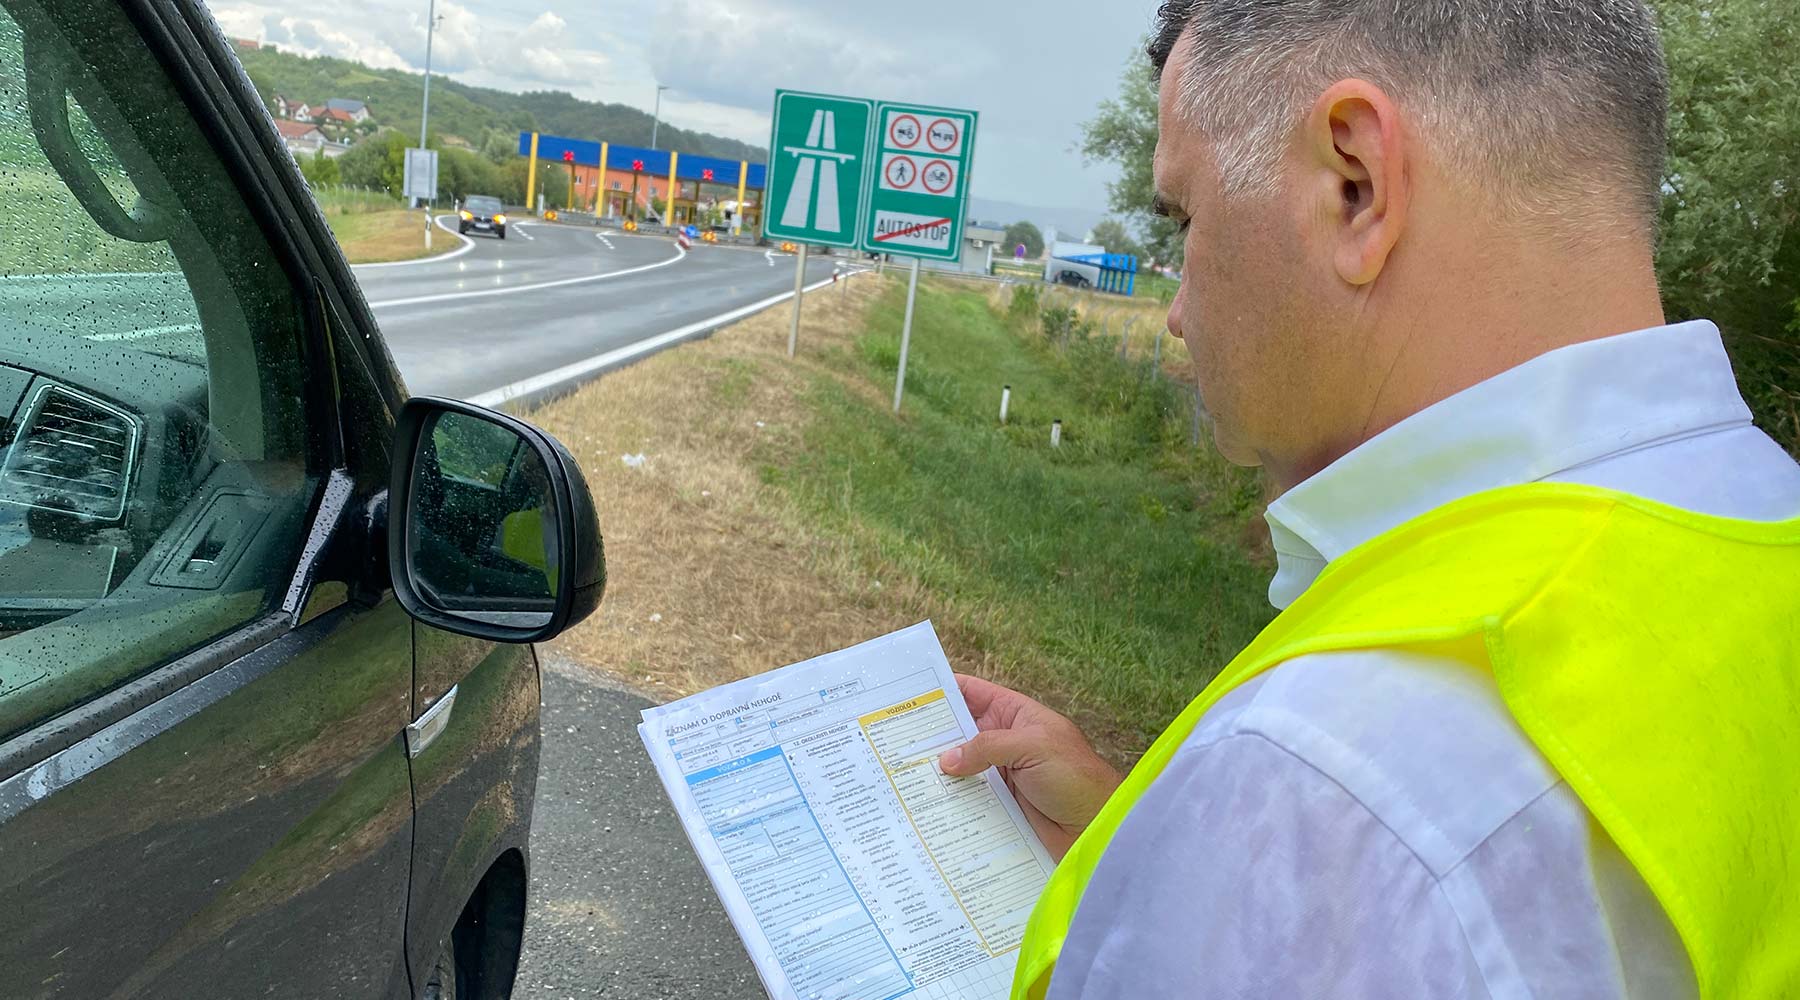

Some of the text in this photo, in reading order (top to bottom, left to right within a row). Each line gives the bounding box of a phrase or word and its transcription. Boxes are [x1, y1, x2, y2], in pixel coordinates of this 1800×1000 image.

[877, 218, 949, 241] AUTOSTOP
[886, 702, 912, 715] VOZIDLO
[664, 719, 700, 737] ZÁZNAM
[709, 702, 750, 722] DOPRAVNÍ
[716, 758, 745, 773] VOZLO
